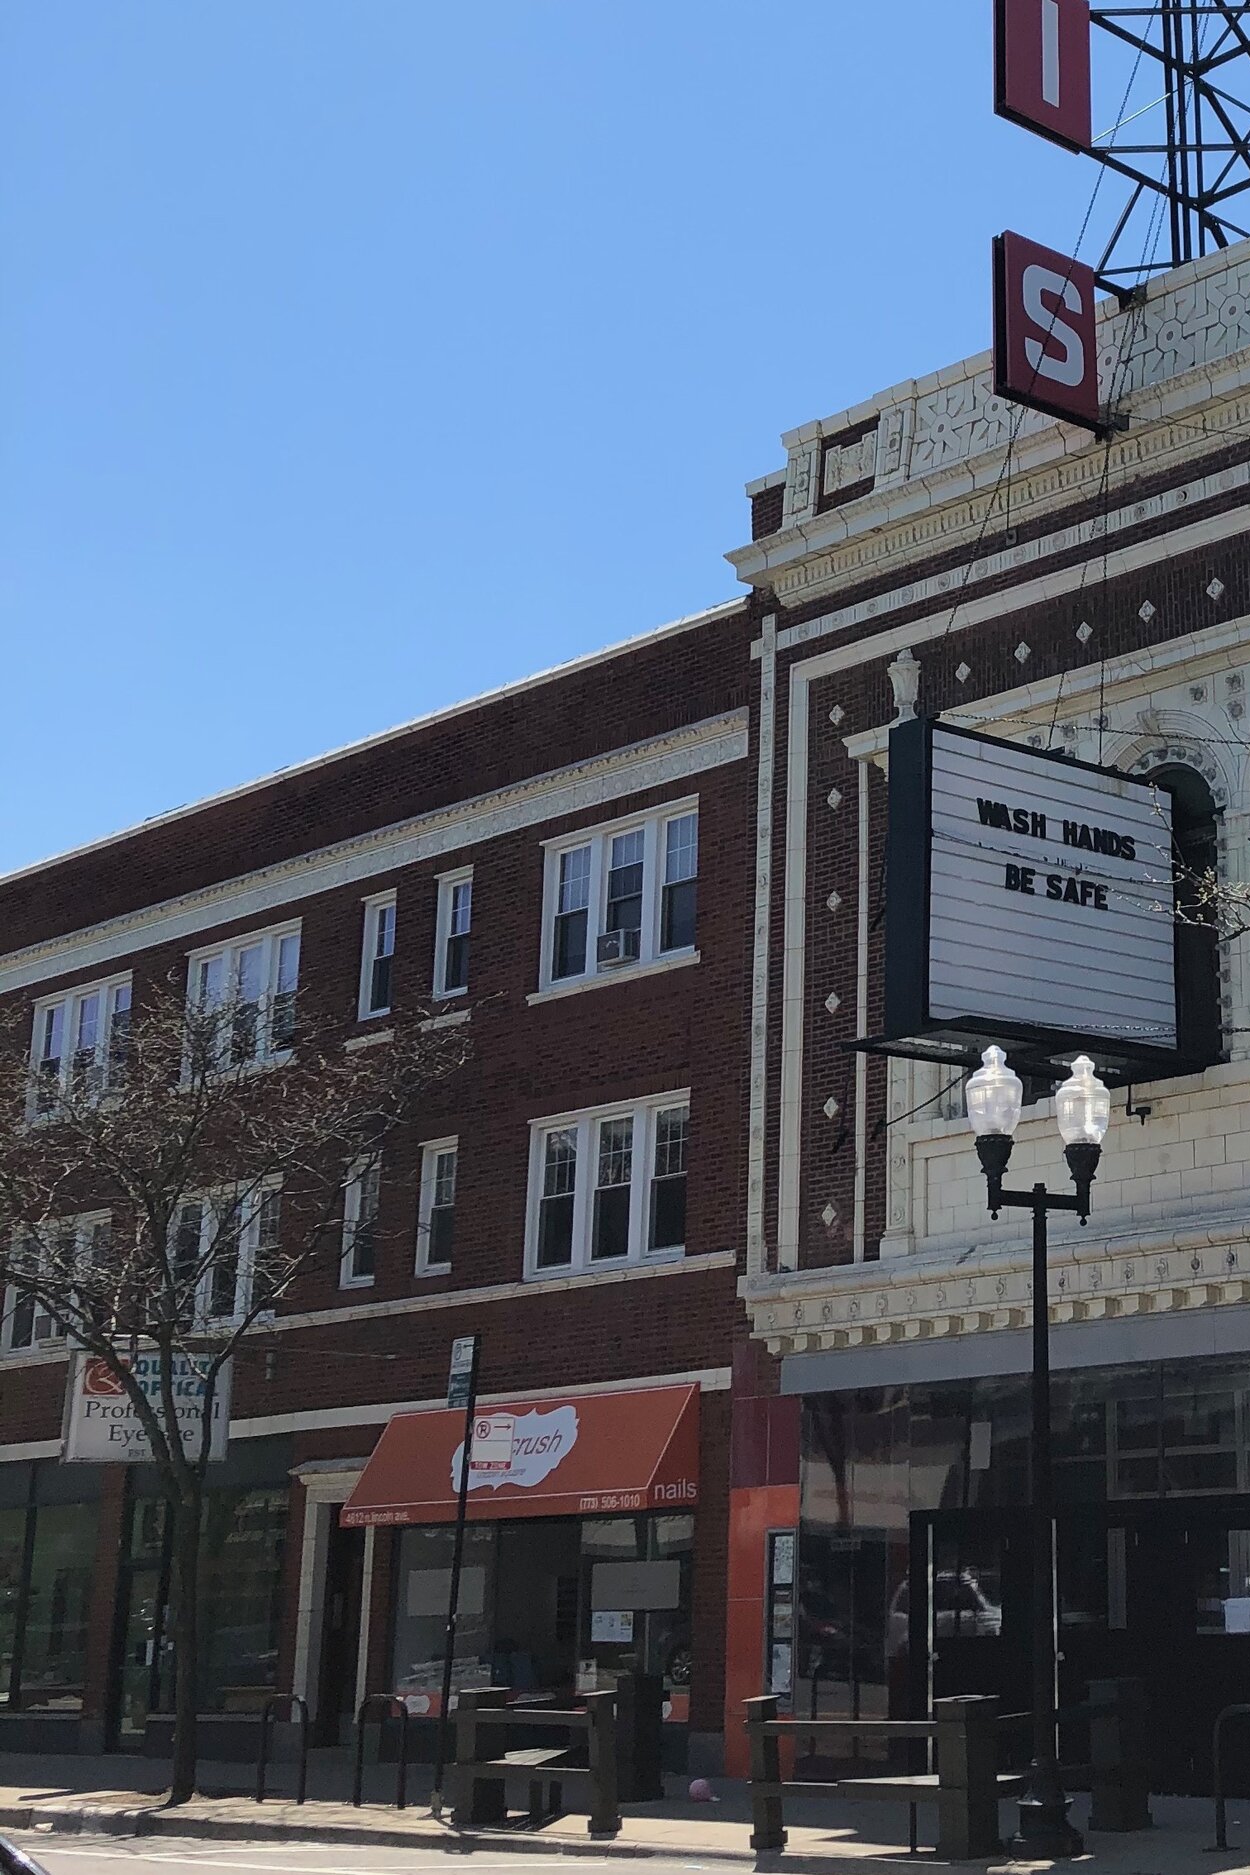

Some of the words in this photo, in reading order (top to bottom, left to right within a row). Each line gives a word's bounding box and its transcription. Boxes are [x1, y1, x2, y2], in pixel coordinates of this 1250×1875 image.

[977, 798, 1046, 839] WASH
[1063, 819, 1136, 860] HANDS
[1005, 863, 1035, 895] BE
[1046, 874, 1109, 910] SAFE
[580, 1497, 599, 1510] (773)
[601, 1493, 641, 1509] 506-1010
[654, 1478, 697, 1500] nails
